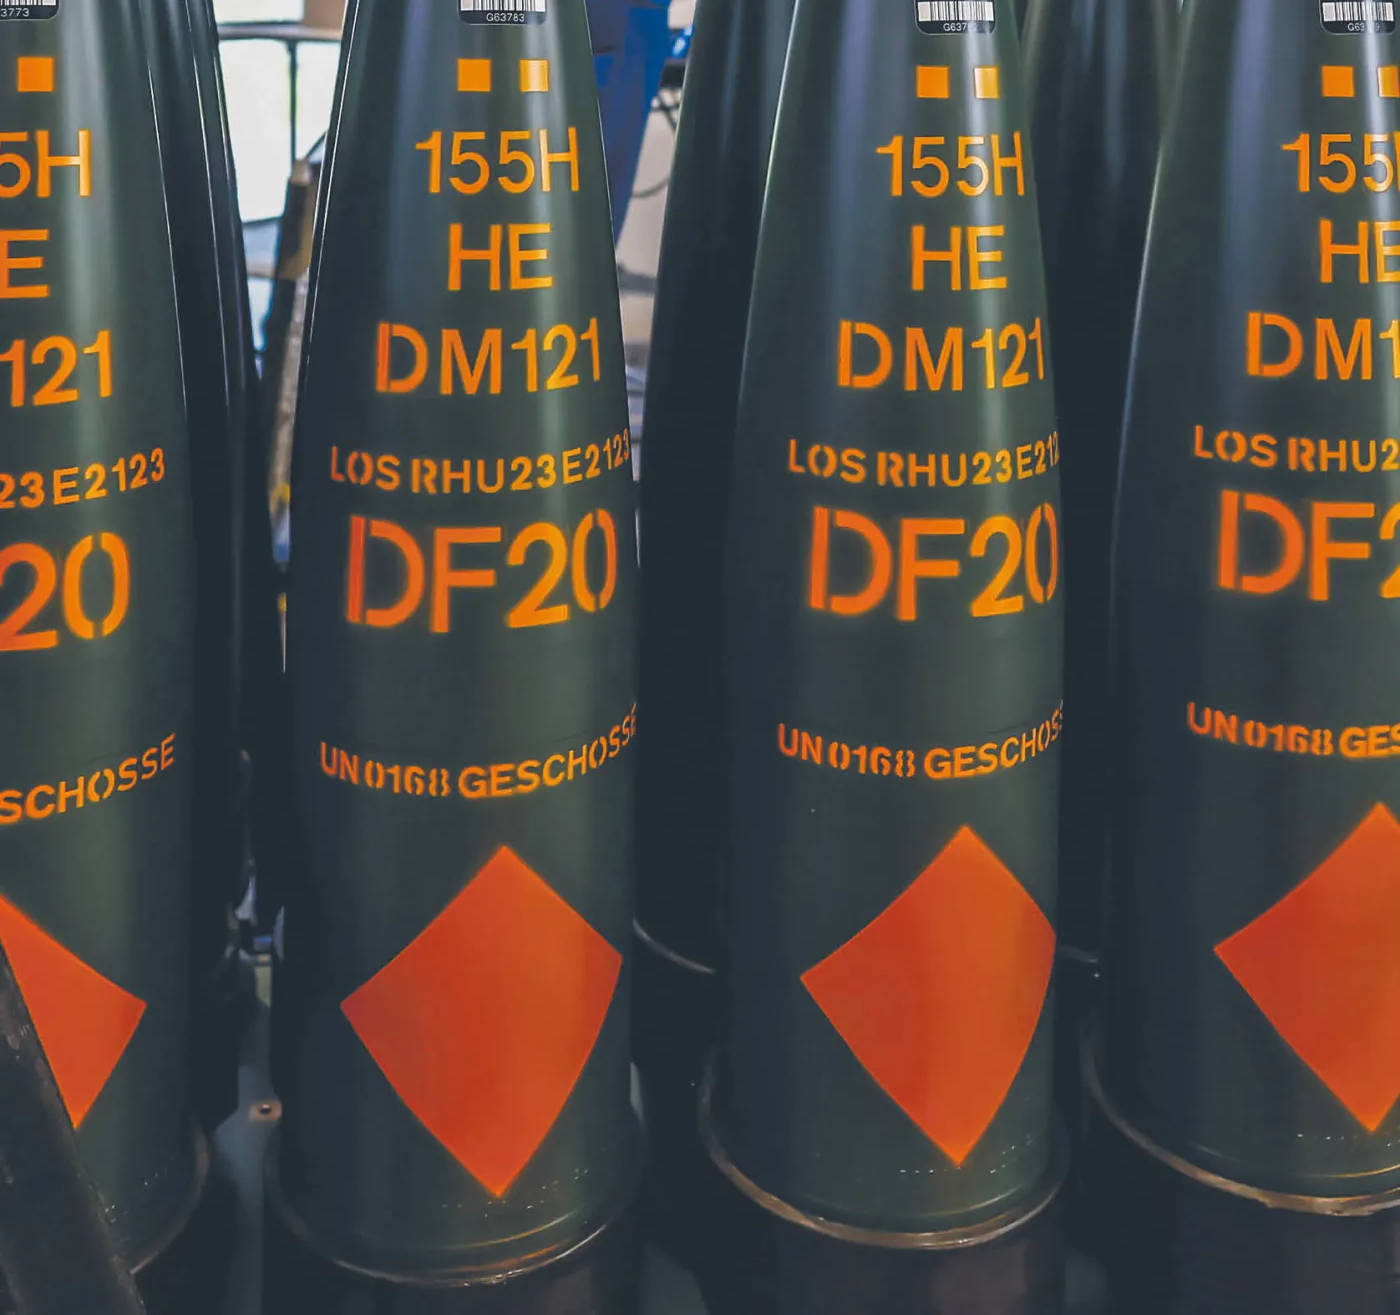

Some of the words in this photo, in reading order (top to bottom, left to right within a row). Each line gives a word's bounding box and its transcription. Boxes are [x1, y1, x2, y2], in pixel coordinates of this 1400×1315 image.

[486, 12, 525, 22] G63783
[416, 127, 580, 195] 155H
[876, 131, 1025, 197] 155H
[1281, 131, 1400, 193] 155
[0, 228, 50, 299] E
[448, 222, 555, 291] HE
[911, 224, 1009, 291] HE
[1318, 218, 1400, 284] HE
[0, 329, 112, 408] 121
[375, 317, 601, 395] DM121
[837, 317, 1045, 392] DM121
[1246, 311, 1400, 381] DM1
[1194, 425, 1278, 468] LOS
[0, 532, 131, 652] 20
[346, 509, 617, 634] DF20
[808, 502, 1058, 622] DF20
